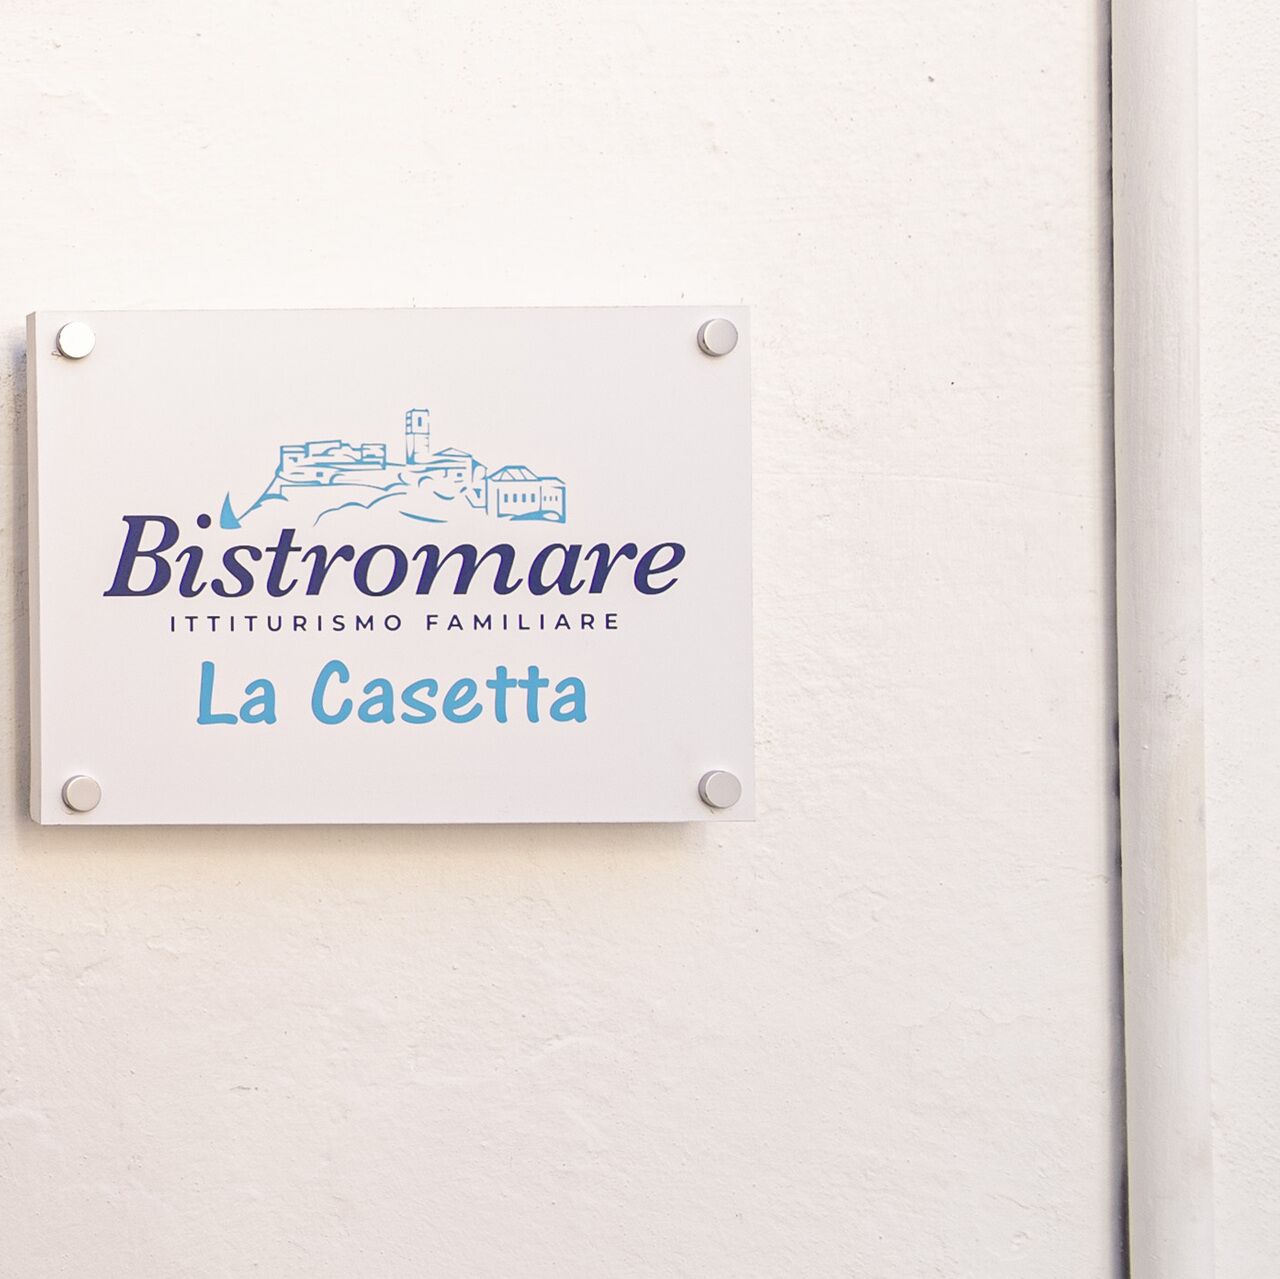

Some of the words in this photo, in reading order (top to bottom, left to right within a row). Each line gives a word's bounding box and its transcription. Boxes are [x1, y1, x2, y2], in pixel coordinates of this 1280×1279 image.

[101, 512, 687, 599] Bistromare
[169, 613, 403, 633] ITTITURISMO
[425, 612, 620, 631] FAMILIARE
[196, 660, 278, 726] La
[310, 659, 588, 725] Casetta
